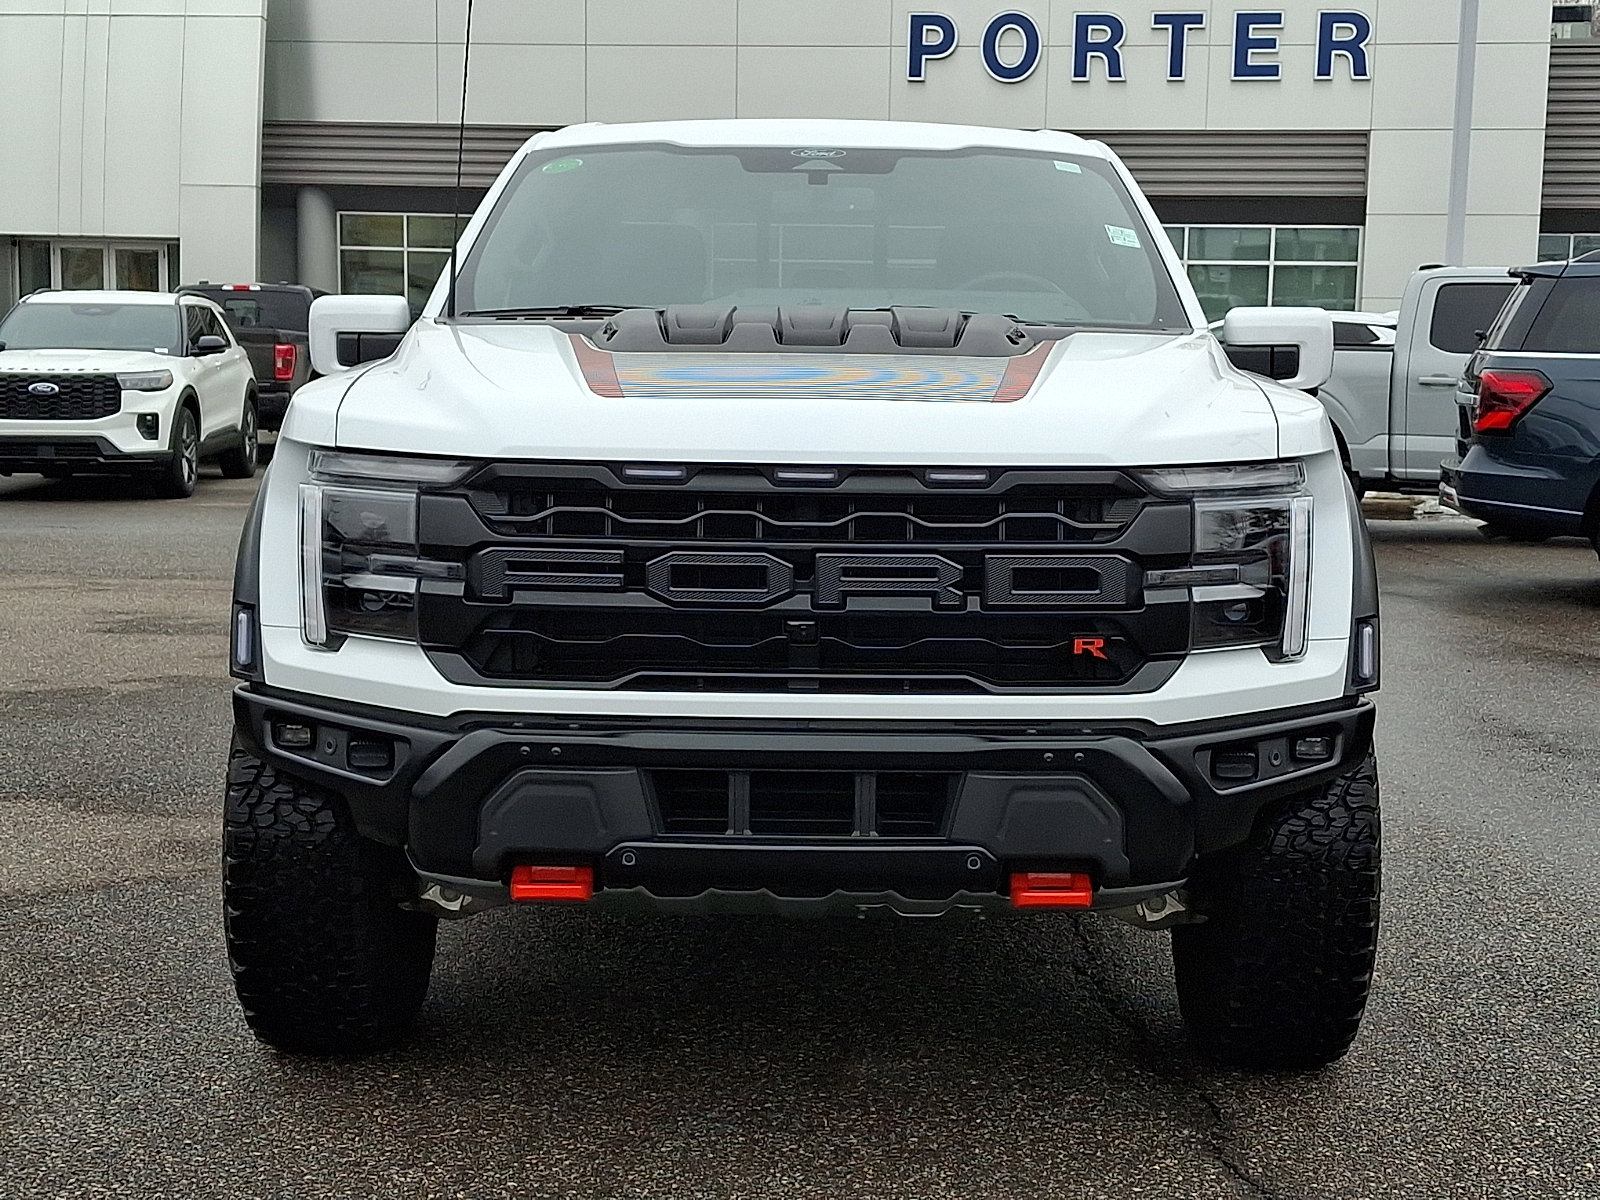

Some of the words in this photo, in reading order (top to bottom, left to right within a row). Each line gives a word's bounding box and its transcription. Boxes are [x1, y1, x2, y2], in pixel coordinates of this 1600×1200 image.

[906, 10, 1373, 83] PORTER
[467, 547, 1143, 605] FORD
[1074, 638, 1107, 659] R
